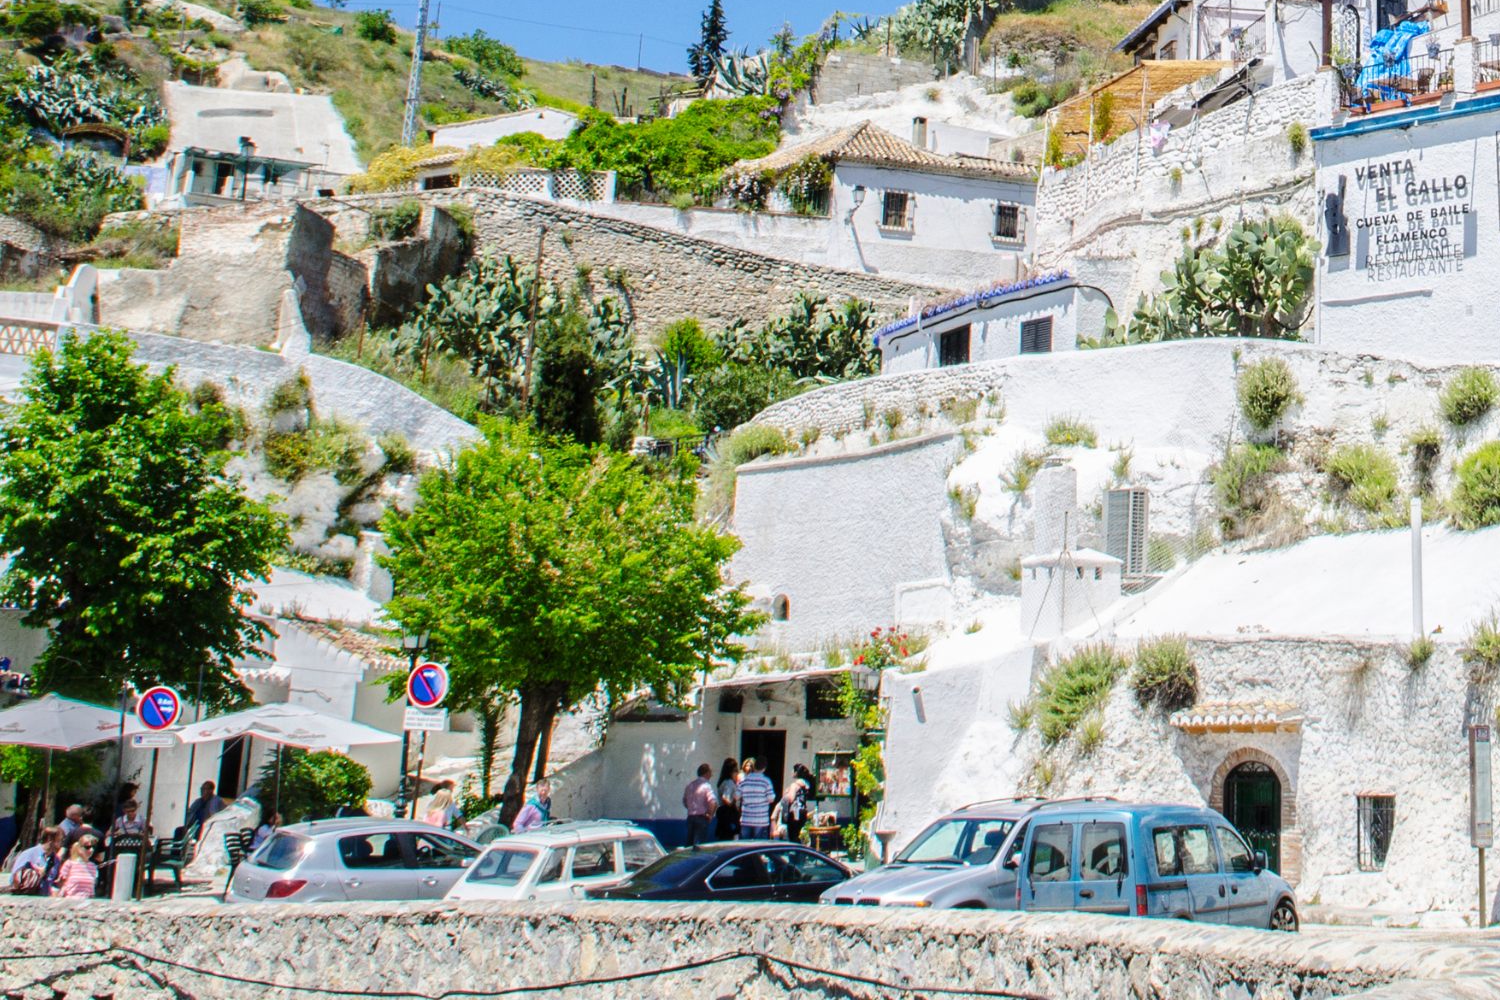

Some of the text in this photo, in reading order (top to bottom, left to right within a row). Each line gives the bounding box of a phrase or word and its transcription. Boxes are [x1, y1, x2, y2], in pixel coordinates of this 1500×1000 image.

[1355, 158, 1414, 181] VENTA
[1375, 174, 1467, 203] EL GALLO
[1356, 203, 1470, 229] CUEVA DE BAILE
[1376, 227, 1448, 245] FLAMENCO
[1365, 243, 1461, 268] RESTAURANTE
